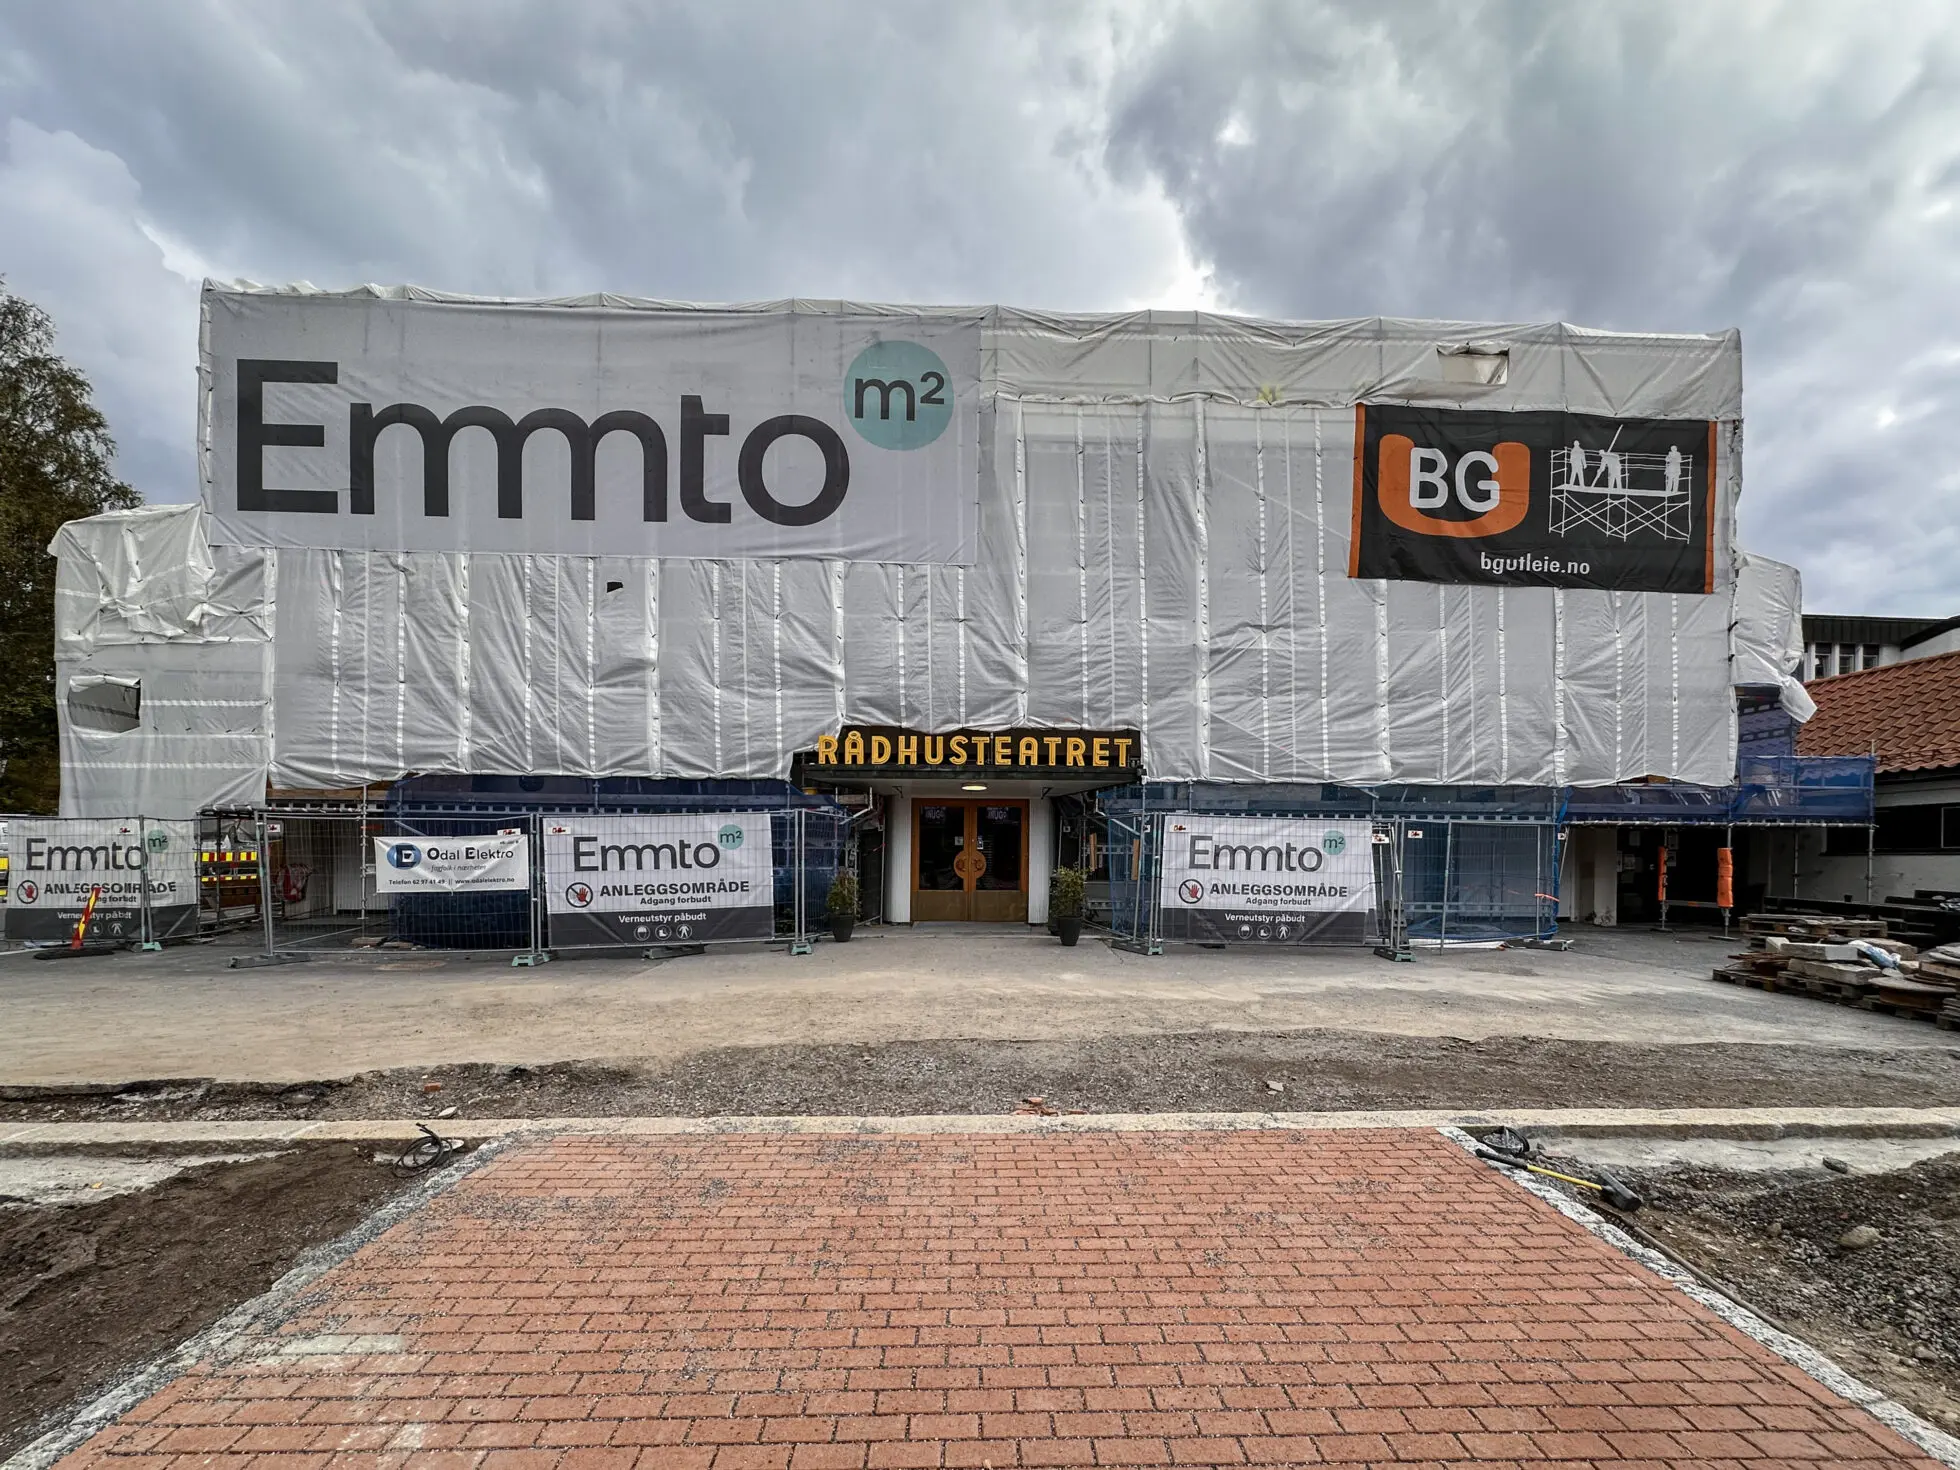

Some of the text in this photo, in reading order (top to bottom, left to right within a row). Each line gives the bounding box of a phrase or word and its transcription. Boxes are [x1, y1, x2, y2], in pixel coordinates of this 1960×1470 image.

[237, 358, 850, 527] Emmto
[1480, 552, 1591, 575] bgutleie.no
[817, 730, 1133, 767] RÅDHUSTEATRET
[26, 837, 149, 871] Emmto
[427, 846, 514, 860] Odal Elektro
[573, 836, 721, 872] Emmto
[1188, 835, 1323, 872] Emmto
[600, 879, 750, 897] ANLEGGSOMRÅDE
[1210, 882, 1348, 898] ANLEGGSOMRÅDE
[640, 895, 711, 906] Adgang forbudt
[1246, 897, 1279, 906] Adgang
[618, 912, 707, 924] Verneutstyr påbudt
[1225, 912, 1306, 924] Verneutstyr påbudt
